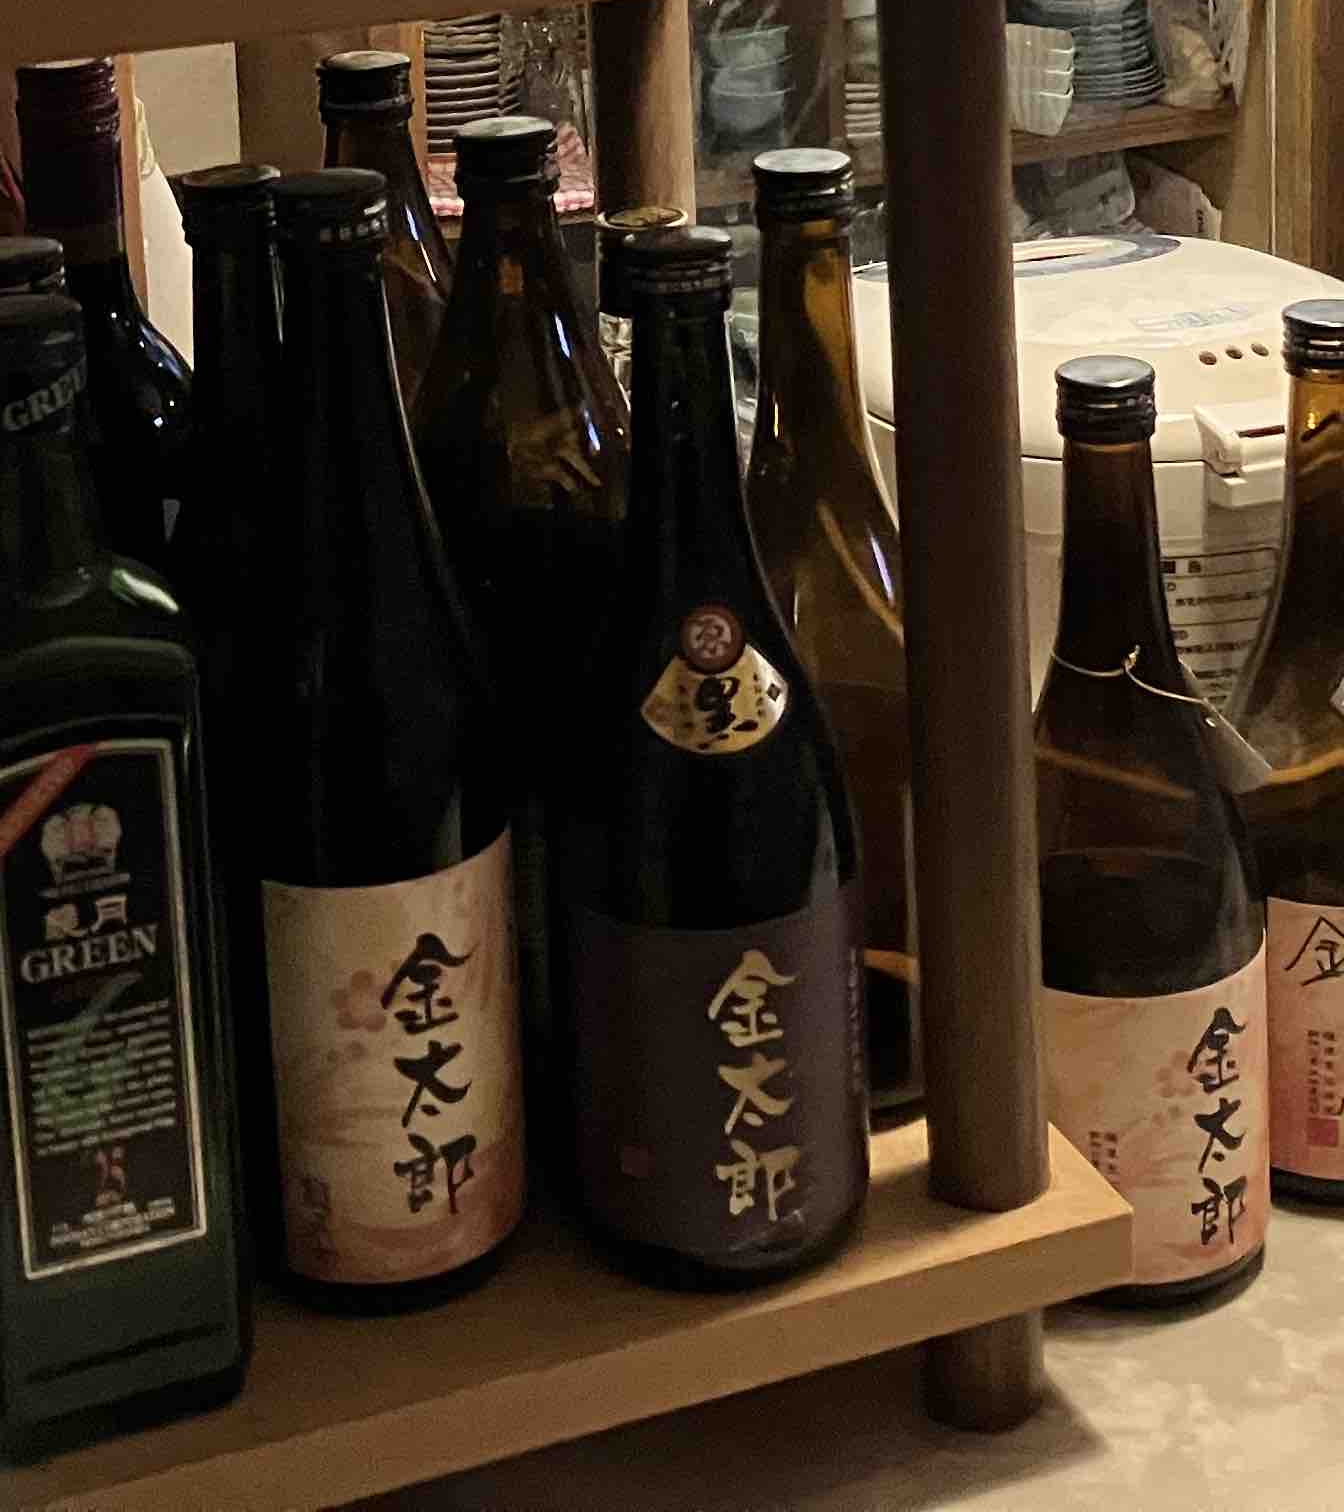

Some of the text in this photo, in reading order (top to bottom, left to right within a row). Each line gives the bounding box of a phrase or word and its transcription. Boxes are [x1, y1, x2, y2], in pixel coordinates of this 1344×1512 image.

[20, 922, 160, 984] GREEN
[381, 932, 478, 1215] 金太郎
[708, 948, 804, 1221] 金太郎
[1187, 1007, 1247, 1246] 金太郎
